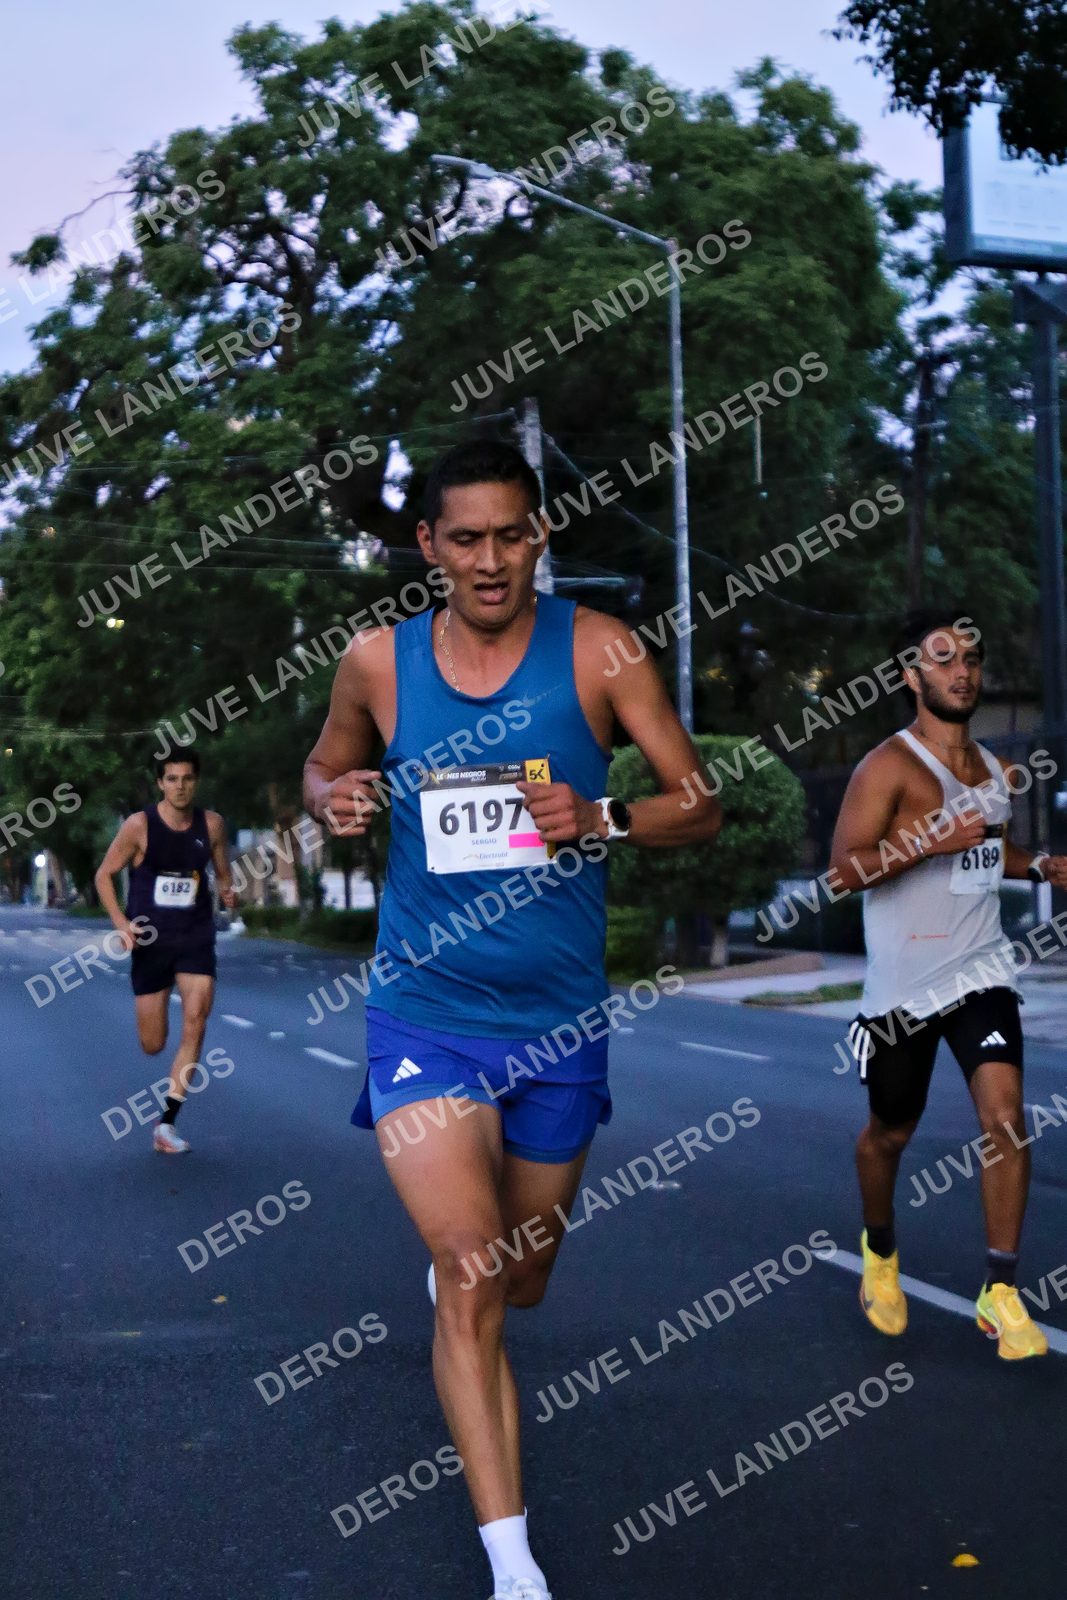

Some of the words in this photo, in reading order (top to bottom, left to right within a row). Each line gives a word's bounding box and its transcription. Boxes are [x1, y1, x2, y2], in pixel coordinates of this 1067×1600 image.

[529, 768, 545, 780] 5K
[439, 797, 523, 835] 6197
[961, 846, 999, 870] 6189
[162, 881, 191, 893] 6182
